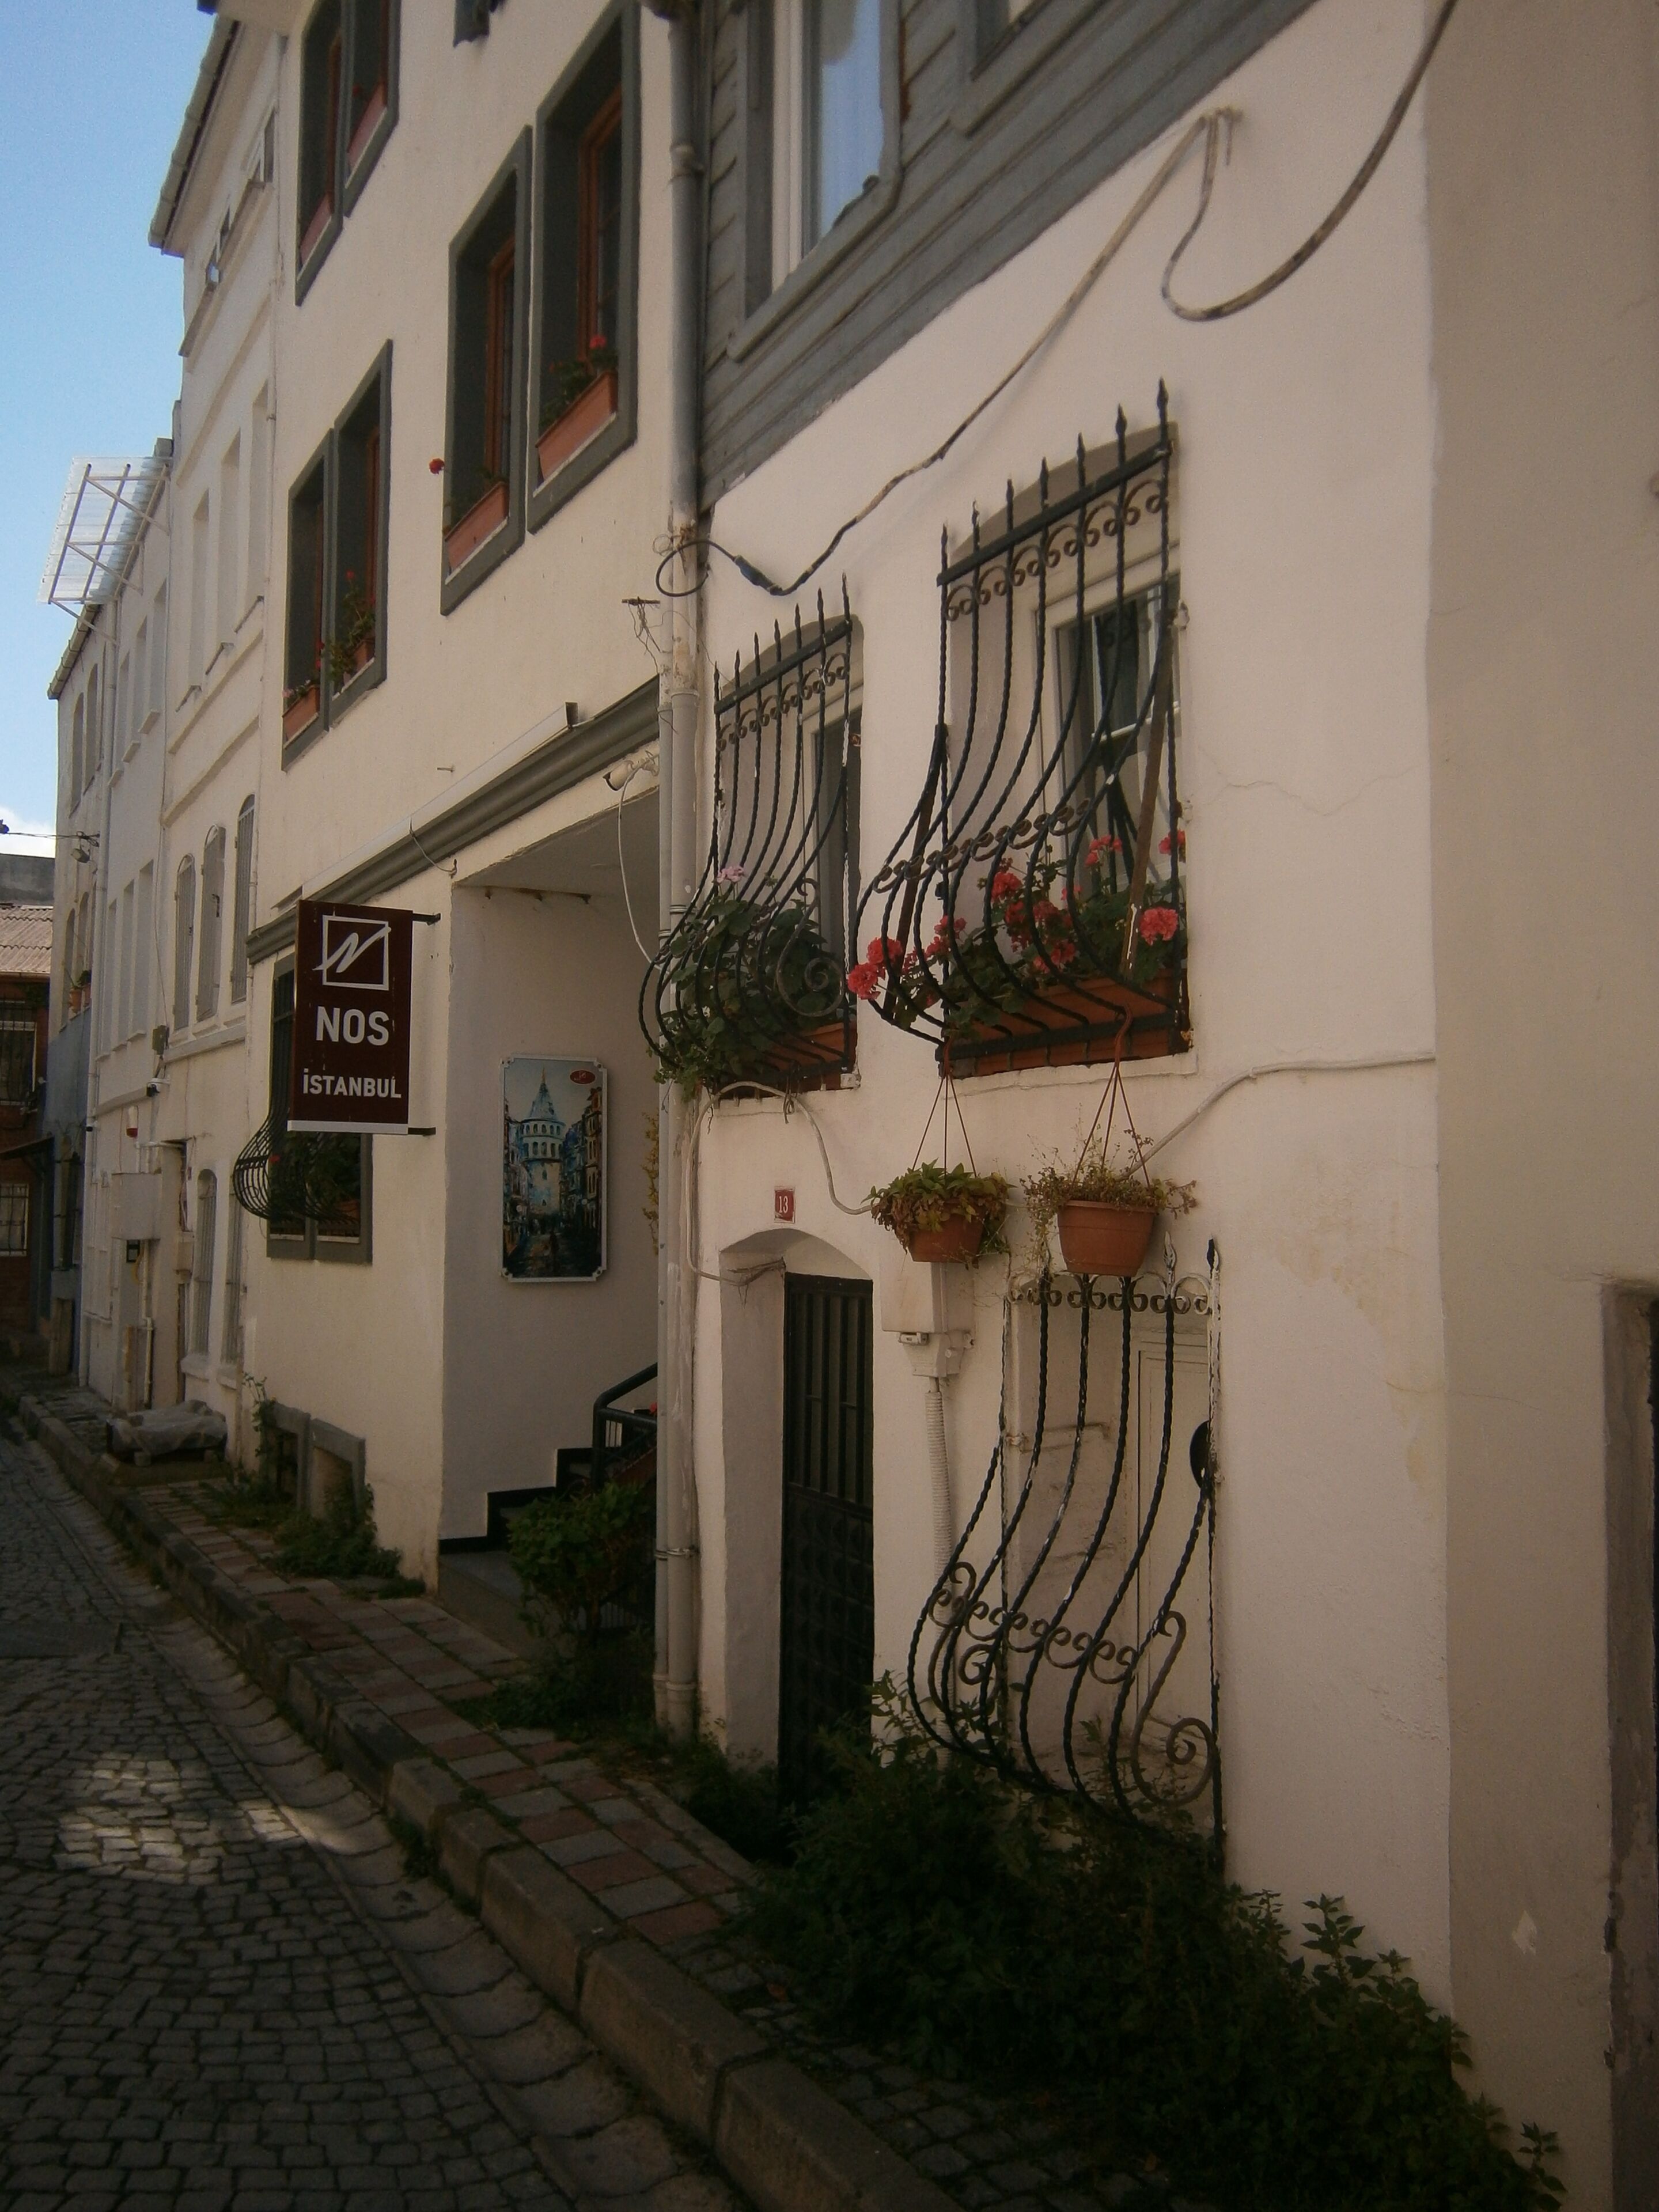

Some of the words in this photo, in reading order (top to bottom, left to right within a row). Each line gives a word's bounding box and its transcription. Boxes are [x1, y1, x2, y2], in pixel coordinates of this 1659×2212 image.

[316, 1006, 390, 1046] NOS
[302, 1068, 402, 1099] İSTANBUL
[779, 1195, 789, 1214] 13
